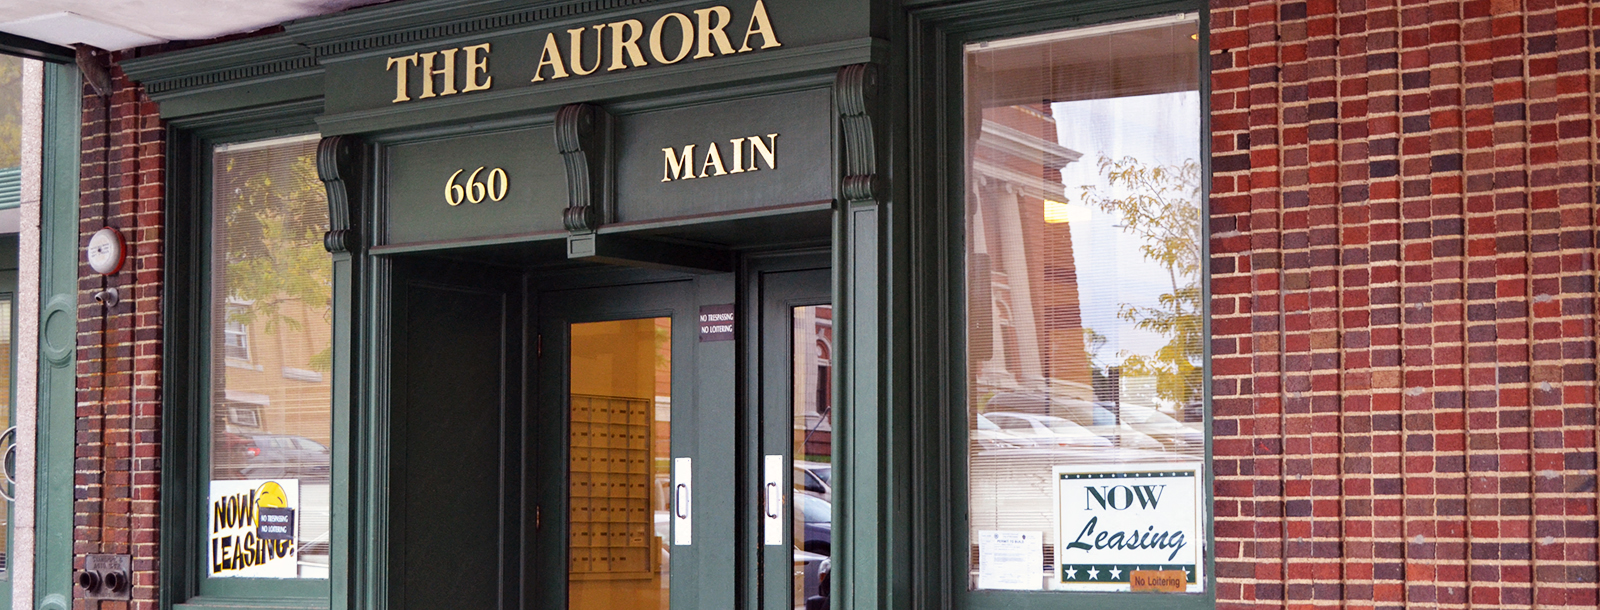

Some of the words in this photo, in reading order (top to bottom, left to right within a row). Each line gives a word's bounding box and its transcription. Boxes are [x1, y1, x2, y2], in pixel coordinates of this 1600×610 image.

[386, 42, 492, 103] THE
[530, 0, 782, 83] AURORA
[661, 133, 779, 183] MAIN
[444, 166, 508, 206] 660
[700, 314, 707, 322] NO
[708, 312, 733, 321] TRESPASSING
[701, 325, 709, 334] NO
[710, 324, 732, 333] LOITERING
[213, 488, 256, 534] NOW
[1084, 484, 1167, 511] NOW
[260, 514, 267, 522] NO
[261, 525, 267, 533] NO
[1066, 515, 1188, 562] Leasing
[1134, 576, 1146, 585] No
[1147, 576, 1181, 588] Loitering
